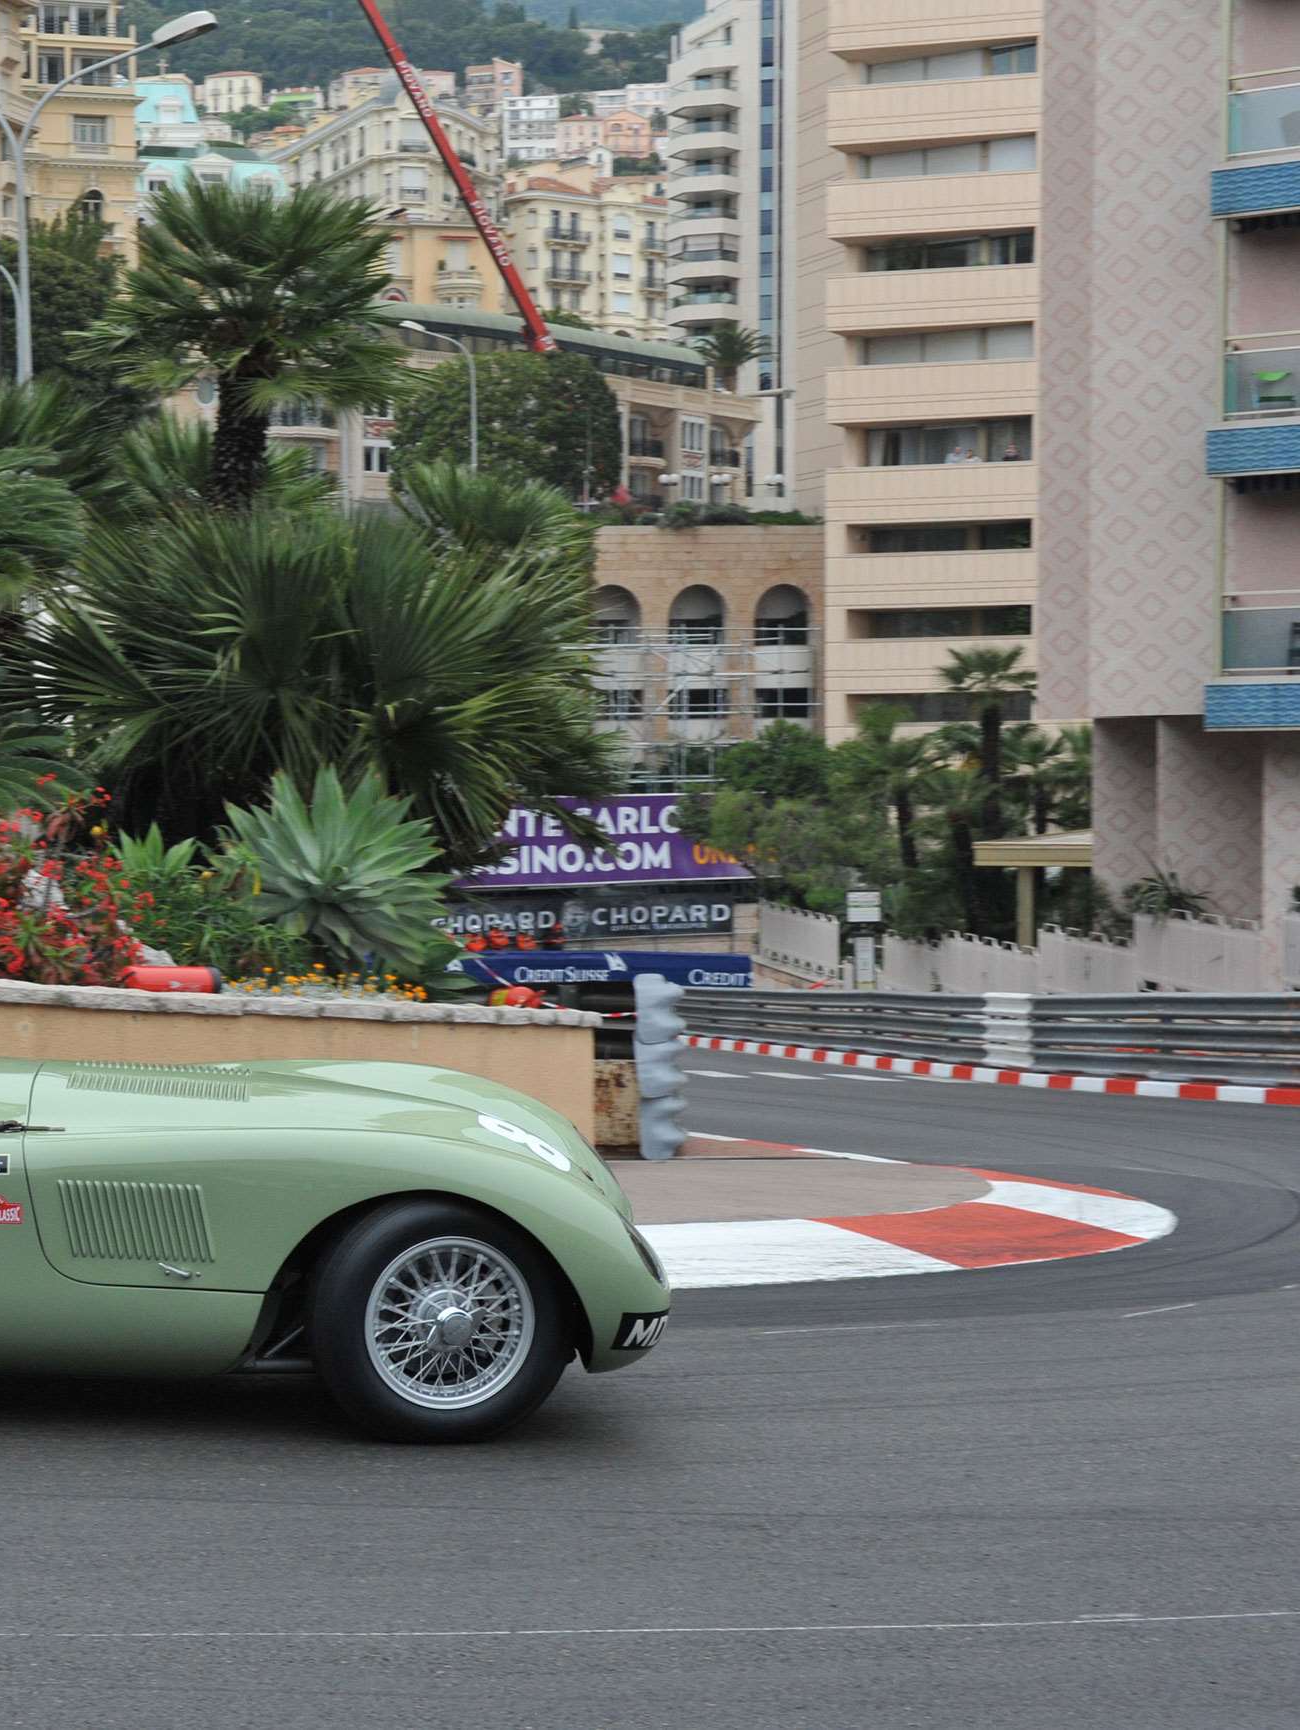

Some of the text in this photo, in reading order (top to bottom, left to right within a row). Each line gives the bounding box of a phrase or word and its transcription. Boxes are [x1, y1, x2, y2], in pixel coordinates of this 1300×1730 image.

[395, 60, 433, 118] PIOVANO
[470, 200, 511, 267] PIOVANO
[574, 805, 681, 836] ARLO
[591, 904, 731, 926] CHOPARD
[513, 966, 563, 983] CREDIT
[688, 968, 745, 986] CREDIT
